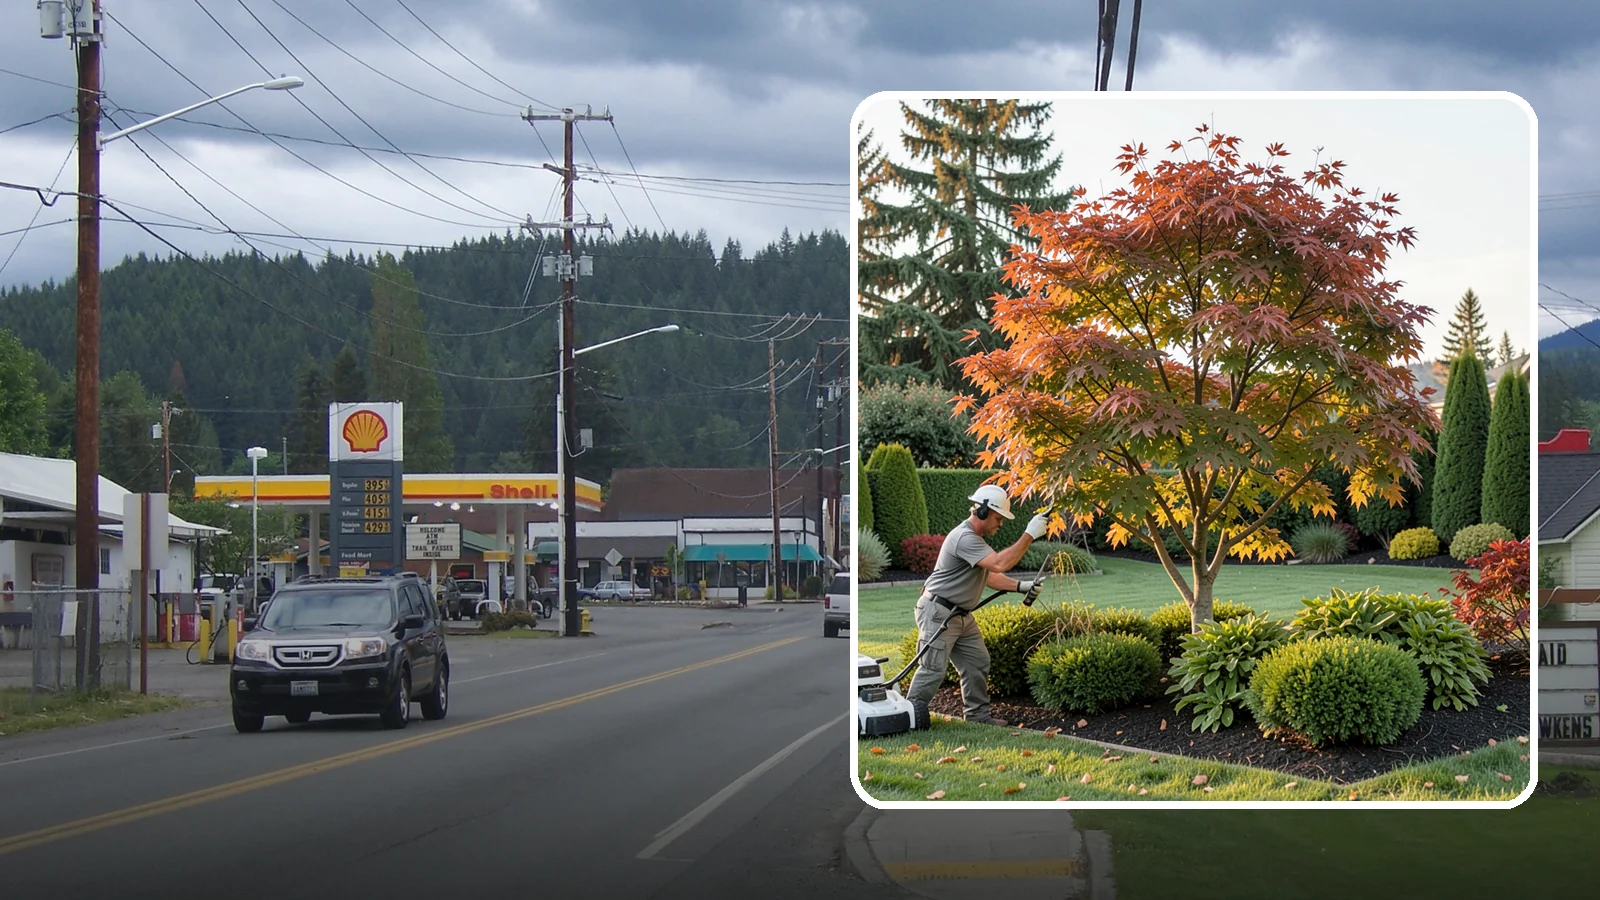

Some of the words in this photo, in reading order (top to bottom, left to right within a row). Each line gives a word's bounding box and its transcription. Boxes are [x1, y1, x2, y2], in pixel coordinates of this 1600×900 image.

[366, 480, 384, 490] 395
[490, 484, 547, 498] Shell
[366, 494, 384, 504] 405
[366, 508, 384, 518] 415
[366, 522, 384, 533] 429
